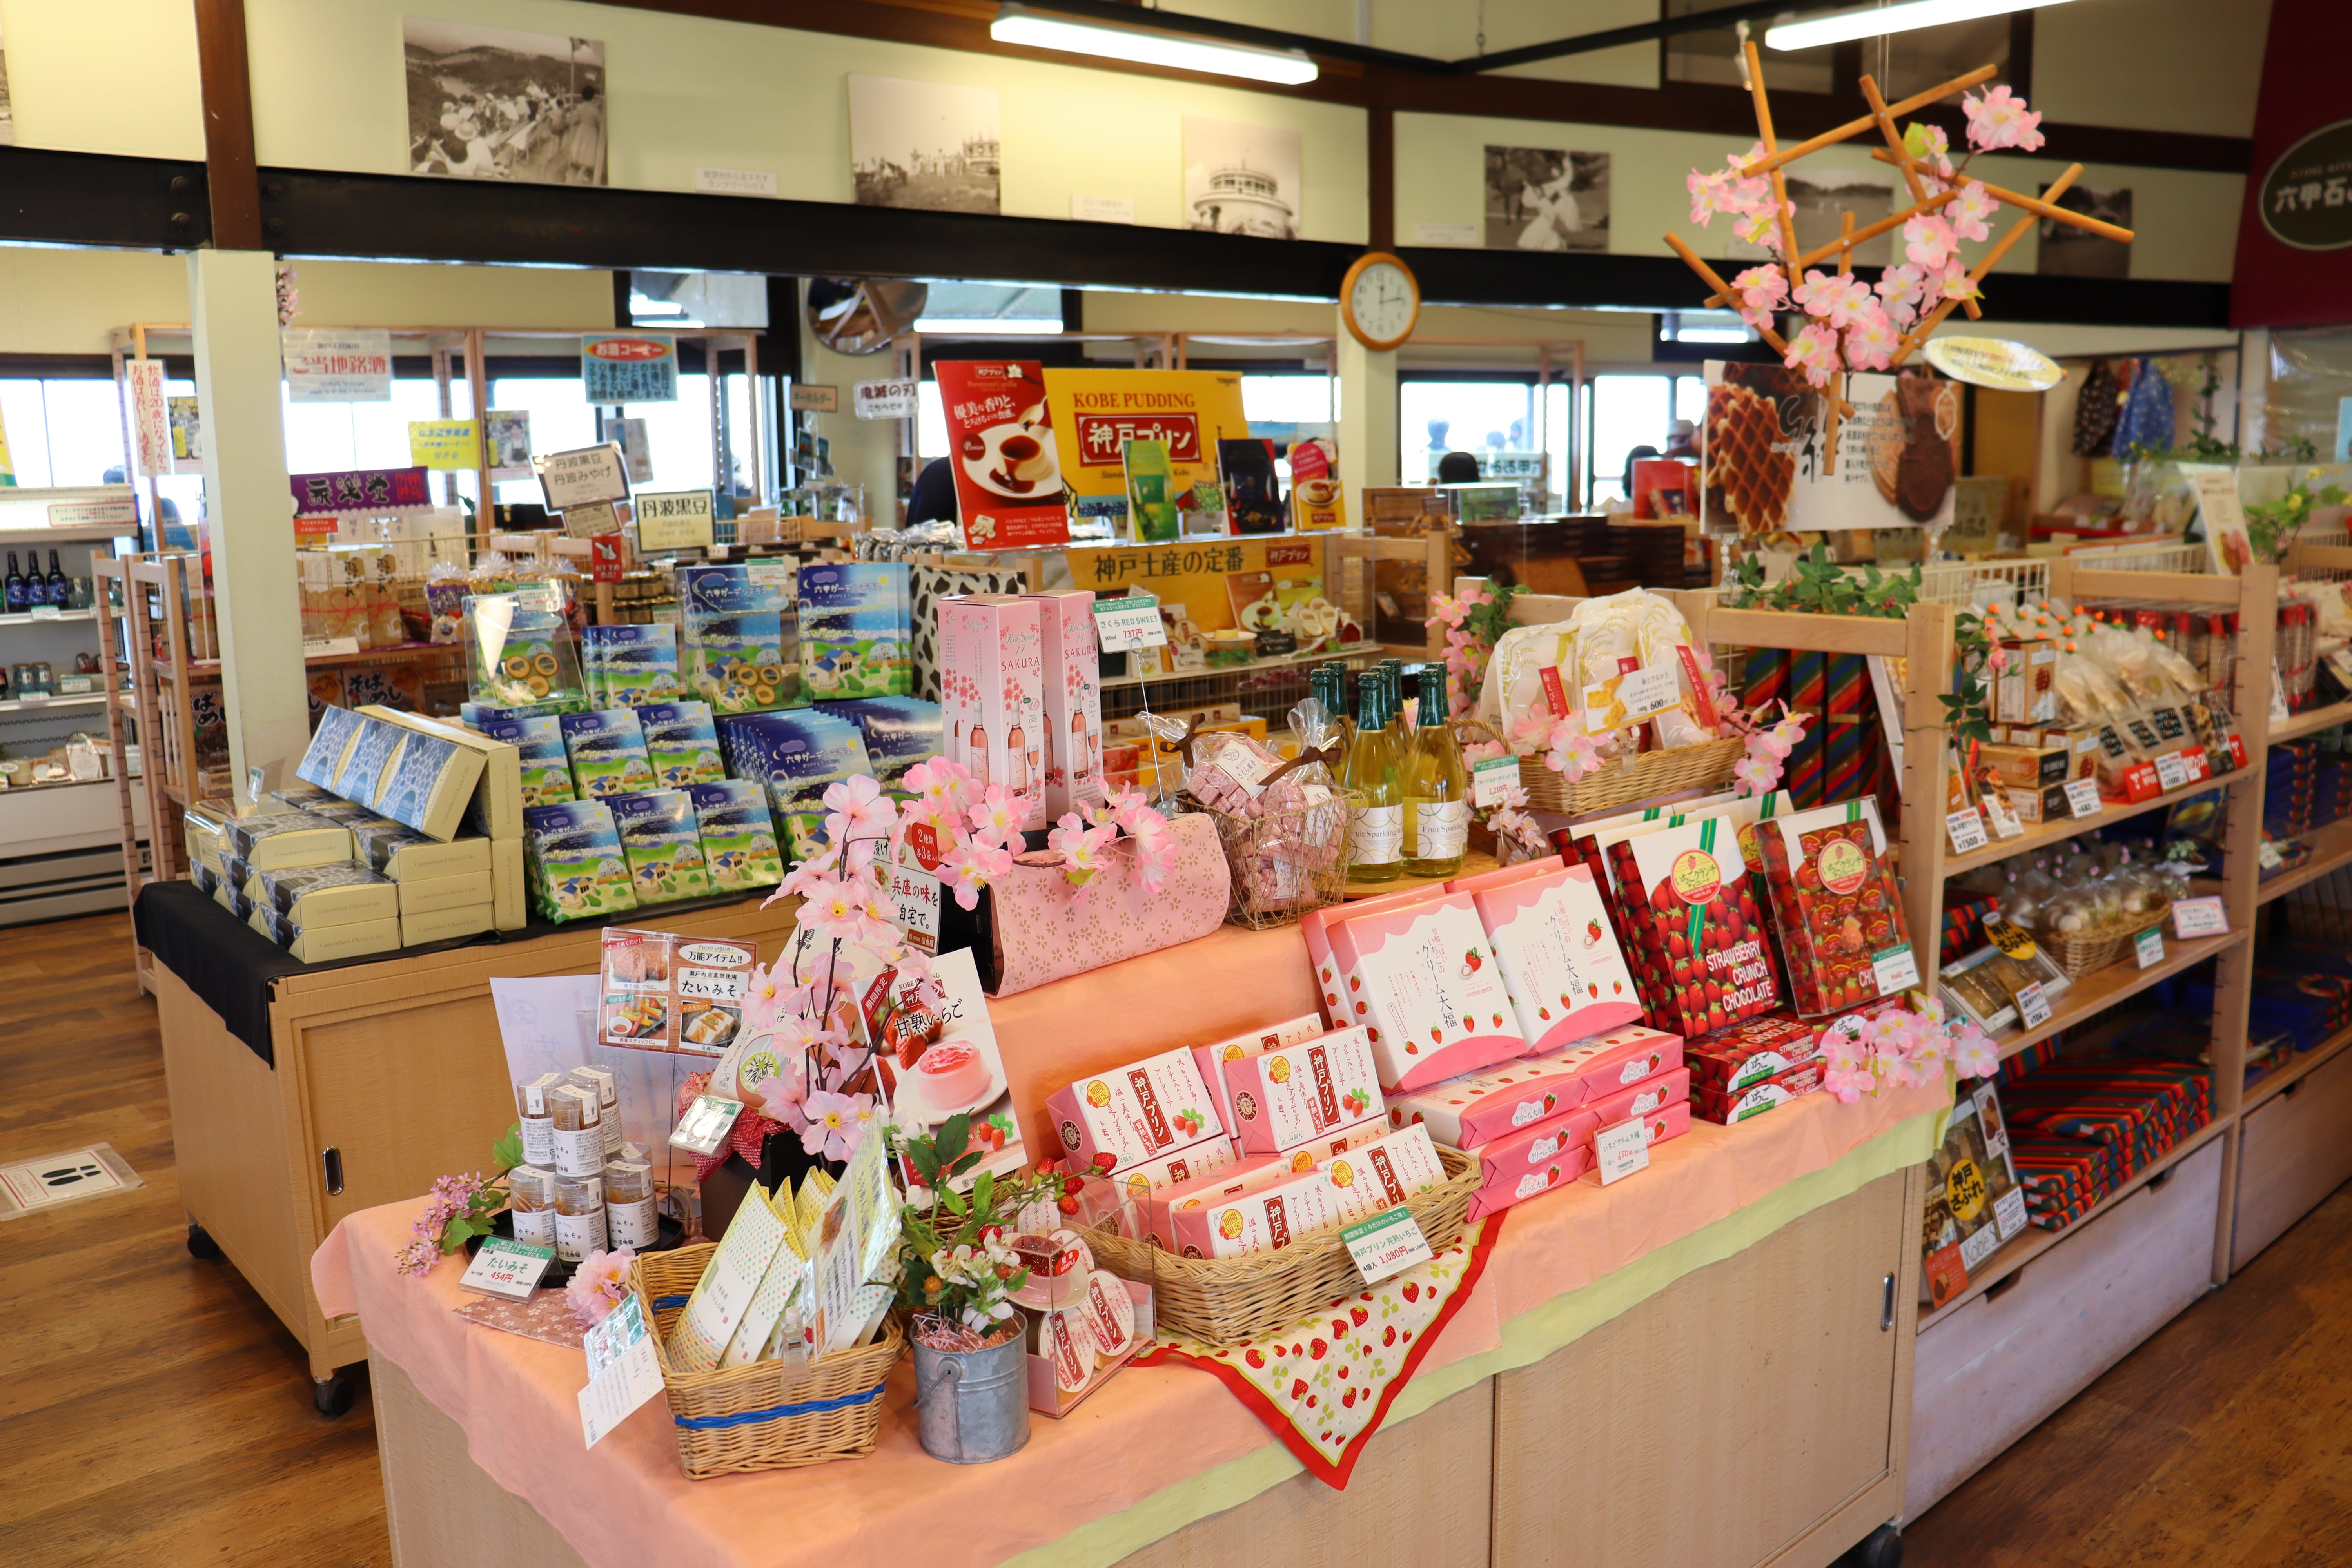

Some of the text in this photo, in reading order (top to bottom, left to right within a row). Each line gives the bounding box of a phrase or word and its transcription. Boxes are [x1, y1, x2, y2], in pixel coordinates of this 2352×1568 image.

[2274, 177, 2352, 213] 六甲石
[293, 356, 386, 374] ご当地銘酒
[1073, 393, 1195, 408] KOBE PUDDING
[555, 453, 601, 470] 丹波黒豆
[554, 466, 612, 486] 丹波みやげ
[642, 497, 708, 518] 丹波黒豆
[1094, 546, 1245, 583] 神戸土産の定番
[1269, 550, 1307, 562] 神戸プリン
[706, 587, 768, 598] 六甲ガーデンテラス
[814, 583, 882, 594] 六甲ガーデンテラス
[1067, 624, 1080, 633] Red
[1100, 620, 1120, 629] さくら
[1137, 615, 1157, 624] SWEET
[1005, 632, 1036, 644] Red Sweet
[1123, 629, 1143, 639] 737円
[1065, 644, 1097, 659] SAKURA
[1002, 656, 1040, 671] SAKURA
[350, 671, 385, 693] そば
[368, 686, 402, 704] めし
[1650, 698, 1664, 710] 600
[785, 748, 853, 764] 六甲ガーデンテラス
[1237, 759, 1256, 779] さくら菓子
[1477, 774, 1510, 785] フルーツスパークリング
[1489, 784, 1507, 795] 1,210円
[918, 829, 934, 846] 2種類
[1367, 829, 1396, 839] Sparkling
[916, 846, 938, 863] 各3袋入り
[1821, 855, 1862, 876] いちごクランチ
[1675, 864, 1717, 887] いちごクランチ
[892, 875, 938, 907] 兵庫の味を
[1557, 899, 1572, 933] 甘酸っぱい
[921, 937, 934, 947] 伍魚福
[1431, 927, 1448, 962] 甘酸っぱい
[688, 951, 742, 964] 万能アイテム!!
[1427, 937, 1445, 973] いちごの
[1550, 916, 1583, 995] クリーム大福
[1706, 940, 1760, 973] STRAWBERRY
[689, 970, 737, 980] 瀬戸内産真鯛使用
[1732, 960, 1768, 986] CRUNCH
[682, 980, 737, 997] たいみそ
[864, 976, 888, 1011] 期間限定
[898, 980, 915, 991] KOBE
[1423, 945, 1458, 1028] クリーム大福
[1723, 980, 1773, 1012] CHOCOLATE
[683, 1003, 709, 1011] かけるだけ！
[1863, 1000, 1896, 1018] STRAWBERRY
[894, 998, 964, 1040] 甘熟いちご
[1746, 1022, 1803, 1044] CHOCOLATE
[1779, 1034, 1814, 1054] STRAWBERRY
[1791, 1043, 1814, 1056] CRUNCH
[1272, 1057, 1285, 1070] 期間
[1744, 1051, 1769, 1074] いちご
[1276, 1068, 1290, 1081] 限定
[1781, 1067, 1817, 1087] STRAWBERRY
[1794, 1075, 1817, 1090] CRUNCH
[1089, 1082, 1103, 1094] 期間
[1313, 1054, 1334, 1117] 神戸プリン
[1094, 1093, 1109, 1106] 限定
[1744, 1084, 1771, 1107] いちご
[1134, 1077, 1165, 1139] 神戸プリン
[1308, 1099, 1322, 1133] 甘熟いちご
[1135, 1121, 1155, 1155] 甘熟いちご
[1289, 1132, 1303, 1142] 4個入
[1119, 1154, 1134, 1164] 4個入
[1618, 1150, 1633, 1160] 650円
[1334, 1164, 1348, 1177] 期間
[1952, 1163, 1973, 1190] 神戸
[1338, 1174, 1353, 1187] 限定
[1951, 1181, 1984, 1212] さぶれ
[1224, 1212, 1238, 1225] 期間
[1344, 1211, 1406, 1240] 期間限定！今だけのいちご味！
[1227, 1223, 1242, 1236] 限定
[495, 1240, 543, 1253] ご飯に合う甘辛仕立て！
[1353, 1226, 1418, 1259] 神戸プリン 完熟いちご
[1964, 1231, 1989, 1267] Kobe
[1062, 1250, 1074, 1265] 見本
[1379, 1246, 1408, 1264] 1,080円
[487, 1257, 529, 1274] たいみそ
[1060, 1258, 1076, 1273] SAMPLE
[1363, 1262, 1378, 1272] 4個入
[490, 1272, 514, 1283] 454円
[710, 1290, 725, 1314] ちりめん山椒
[1091, 1285, 1119, 1337] 神戸プリン
[1055, 1319, 1080, 1374] 神戸プリン
